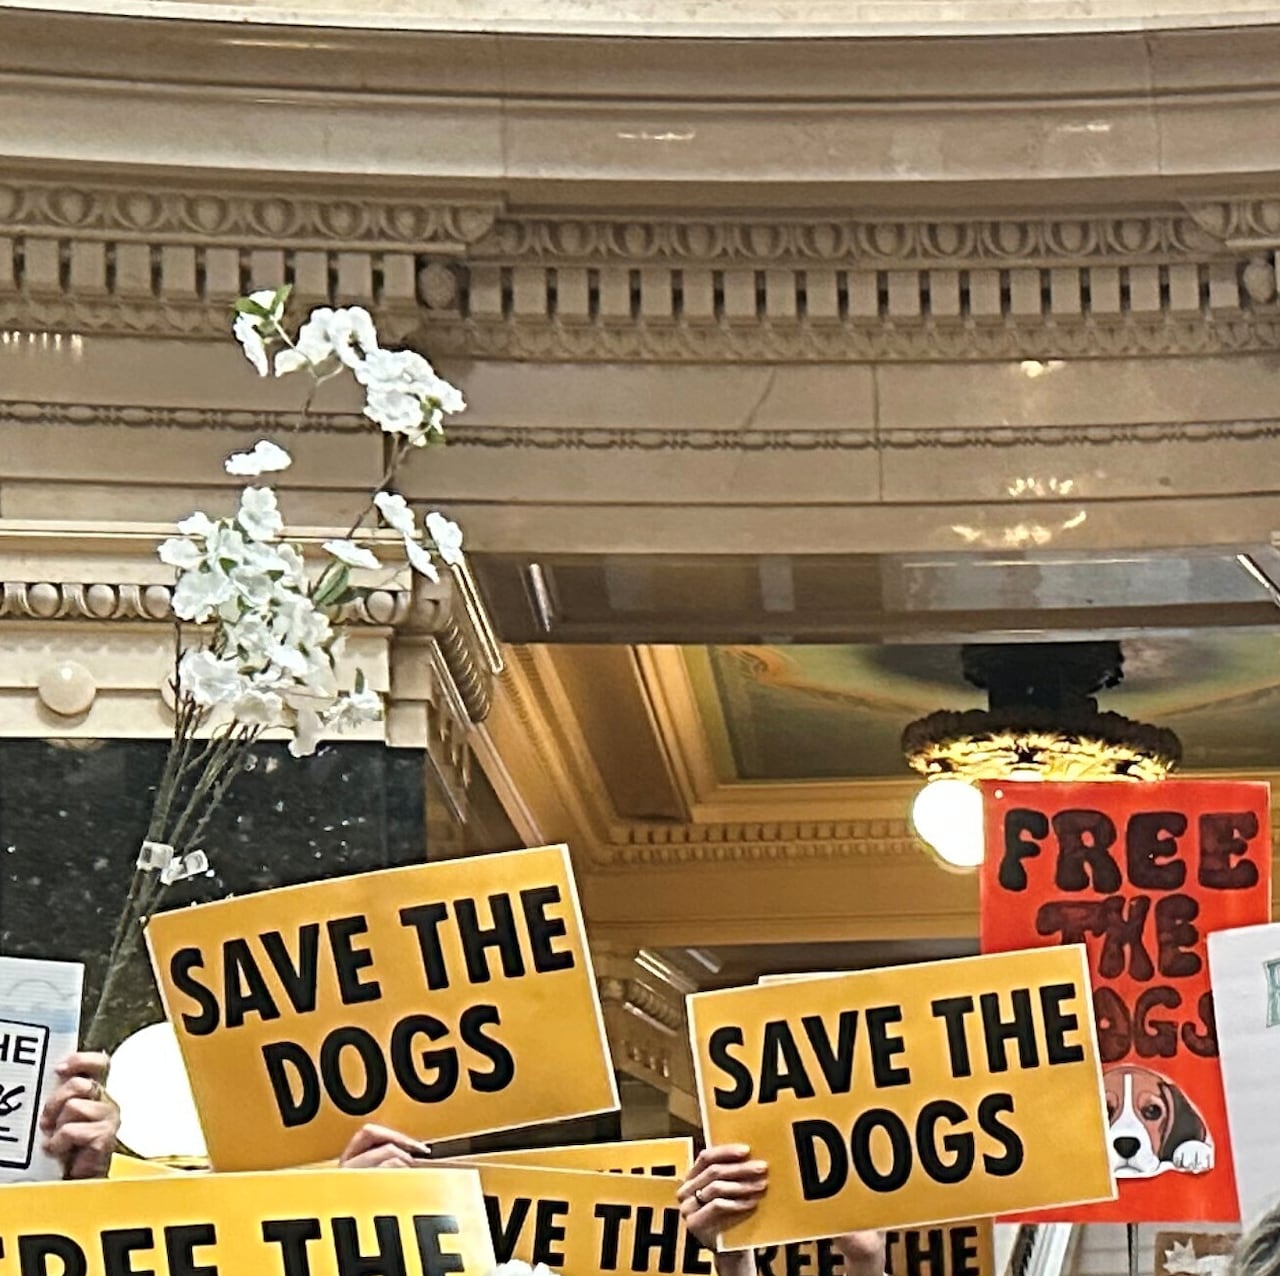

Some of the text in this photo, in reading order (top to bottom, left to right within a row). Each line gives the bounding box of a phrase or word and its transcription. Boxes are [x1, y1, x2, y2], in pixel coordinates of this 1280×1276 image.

[998, 807, 1260, 895] FREE
[170, 885, 576, 1037] SAVE THE
[1036, 893, 1202, 982] THE
[261, 1004, 515, 1129] DOGS
[708, 982, 1084, 1110] SAVE THE
[792, 1093, 1024, 1201] DOGS
